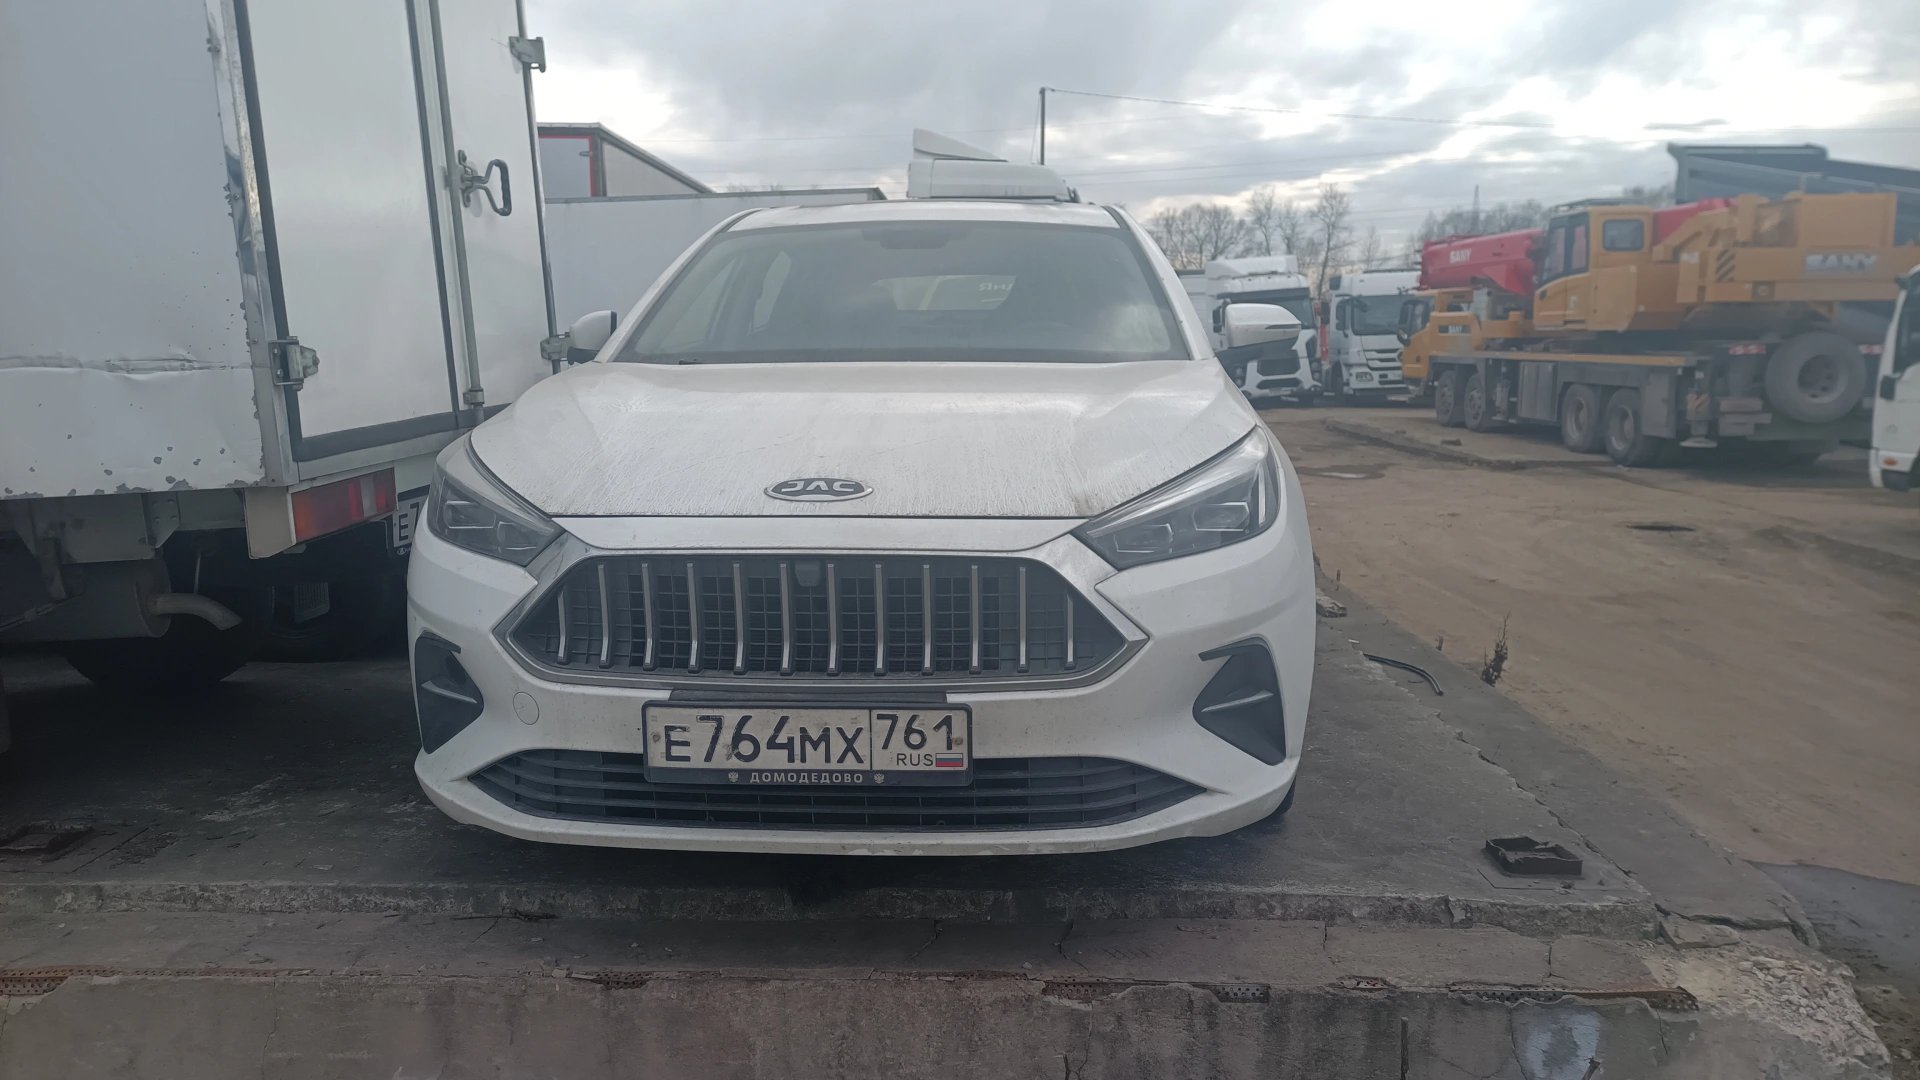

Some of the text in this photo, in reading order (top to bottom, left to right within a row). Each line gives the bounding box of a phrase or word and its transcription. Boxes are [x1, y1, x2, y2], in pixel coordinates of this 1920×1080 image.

[781, 480, 856, 492] JAC
[876, 713, 954, 751] 761
[896, 753, 934, 767] RUS
[750, 772, 864, 785] ДОМОДЕДОВО
